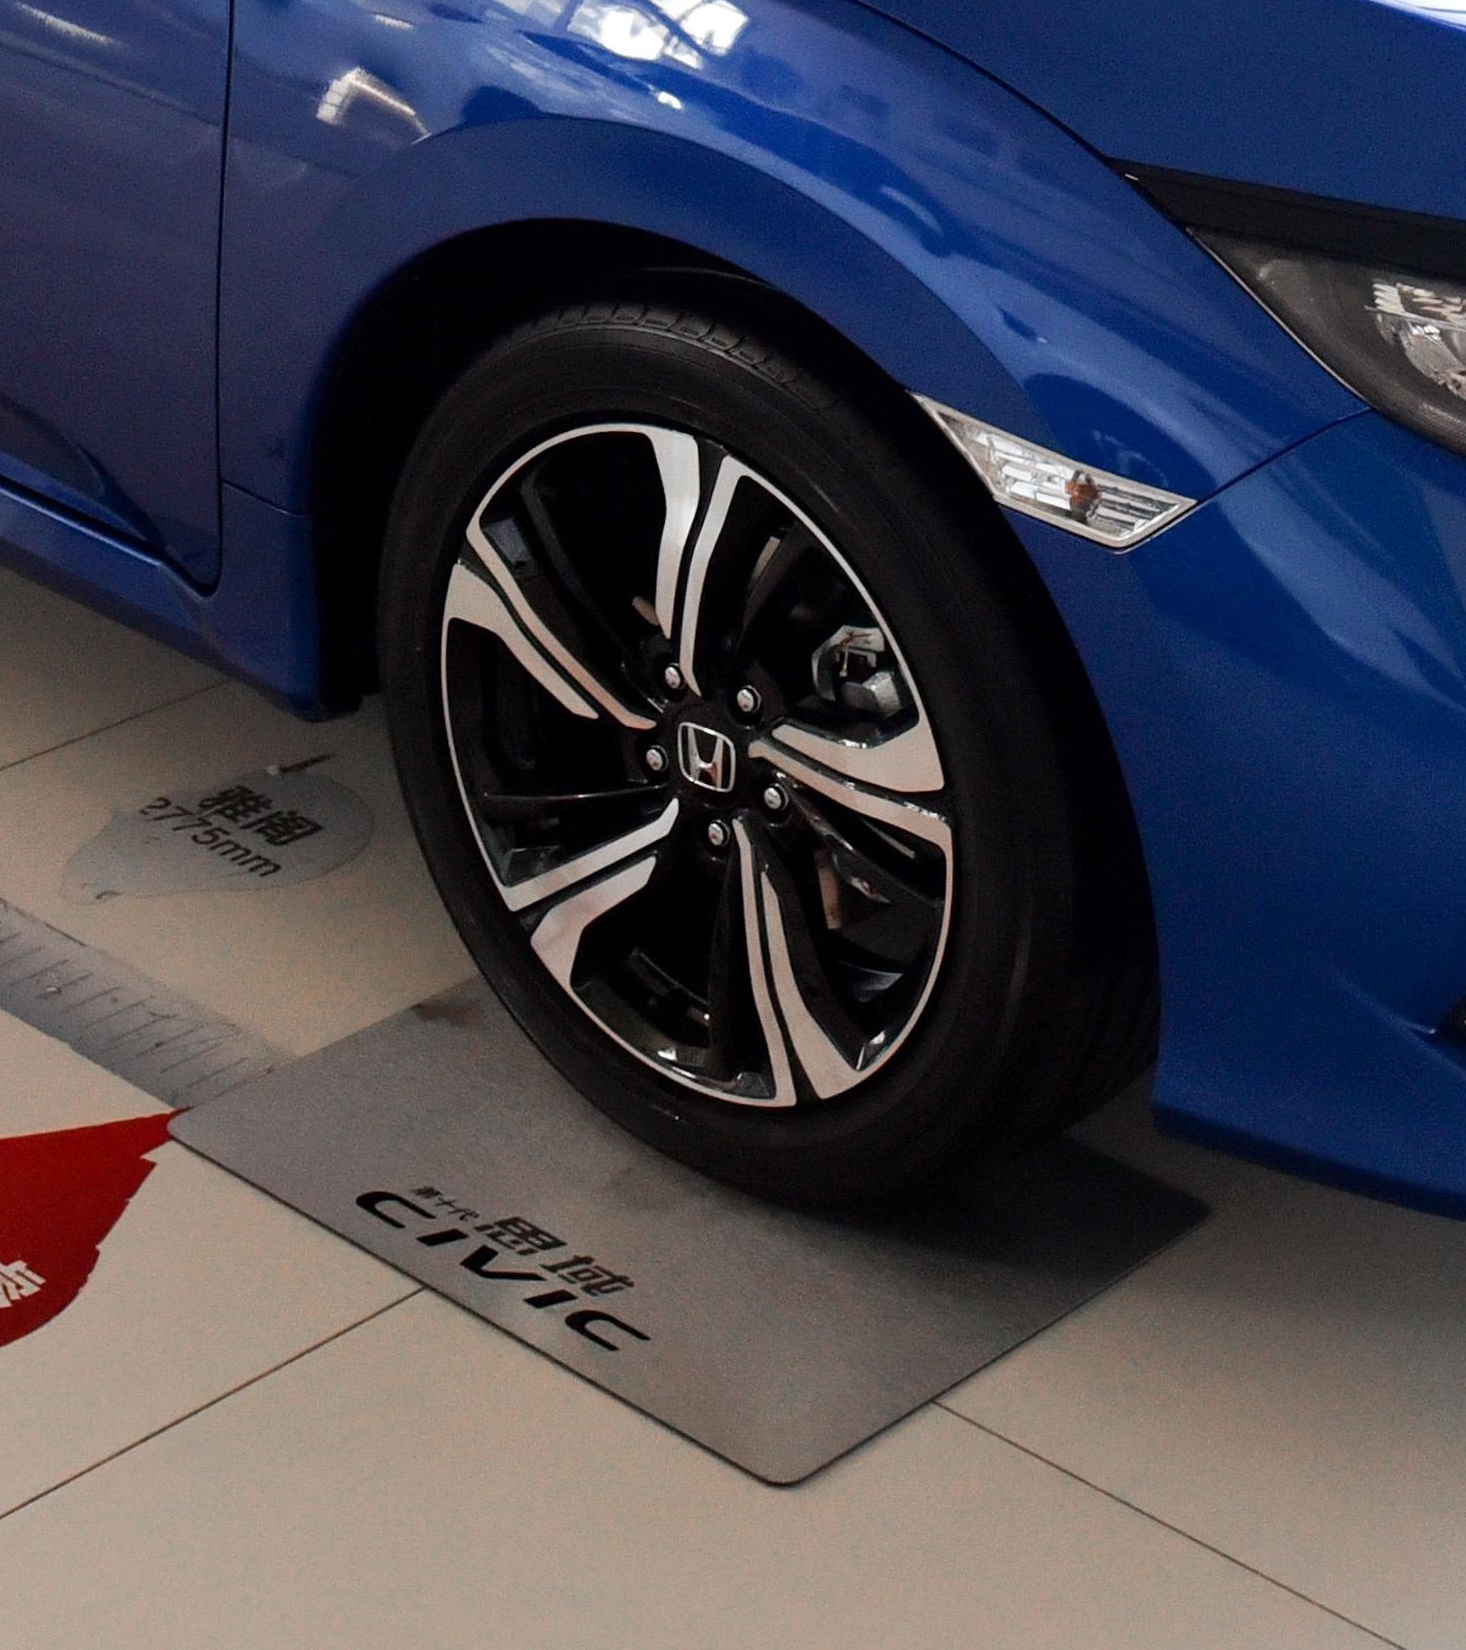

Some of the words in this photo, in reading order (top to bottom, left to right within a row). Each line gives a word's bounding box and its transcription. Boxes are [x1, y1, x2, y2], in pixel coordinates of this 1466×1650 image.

[138, 796, 282, 878] 2775mm
[355, 1191, 652, 1351] CIVIC
[474, 1216, 635, 1297] 思域
